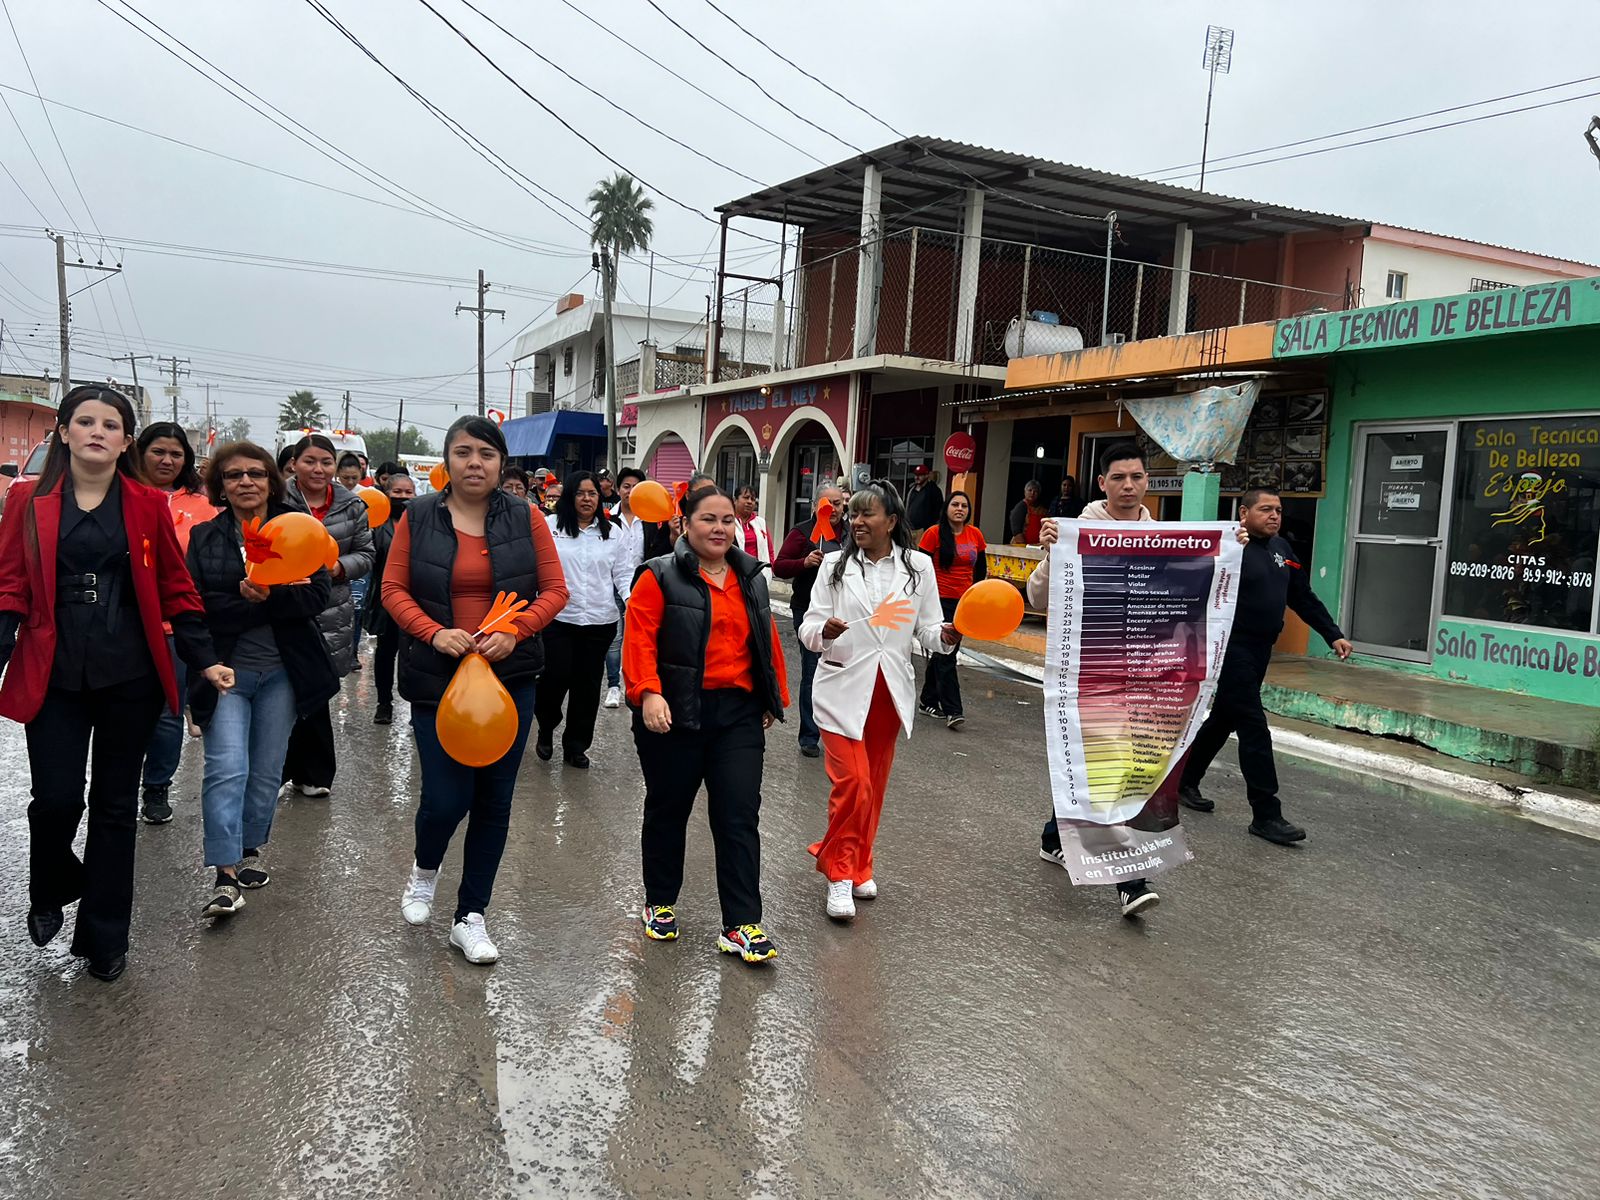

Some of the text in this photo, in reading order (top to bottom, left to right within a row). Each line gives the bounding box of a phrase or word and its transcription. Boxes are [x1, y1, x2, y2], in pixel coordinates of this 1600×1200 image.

[1278, 285, 1571, 353] SALA TECNICA DE BELLEZA
[729, 383, 817, 413] TACOS EL REY
[1475, 425, 1599, 447] Sala Tecnica
[1489, 448, 1581, 468] De Belleza
[1157, 479, 1169, 488] 105
[1170, 479, 1184, 488] 176
[1484, 471, 1566, 501] Espejo
[1088, 533, 1212, 550] Violentómetro
[1507, 554, 1546, 566] CITAS
[1435, 628, 1600, 677] Sala Tecnica De B
[1080, 847, 1144, 865] Instituto
[1085, 869, 1103, 879] en
